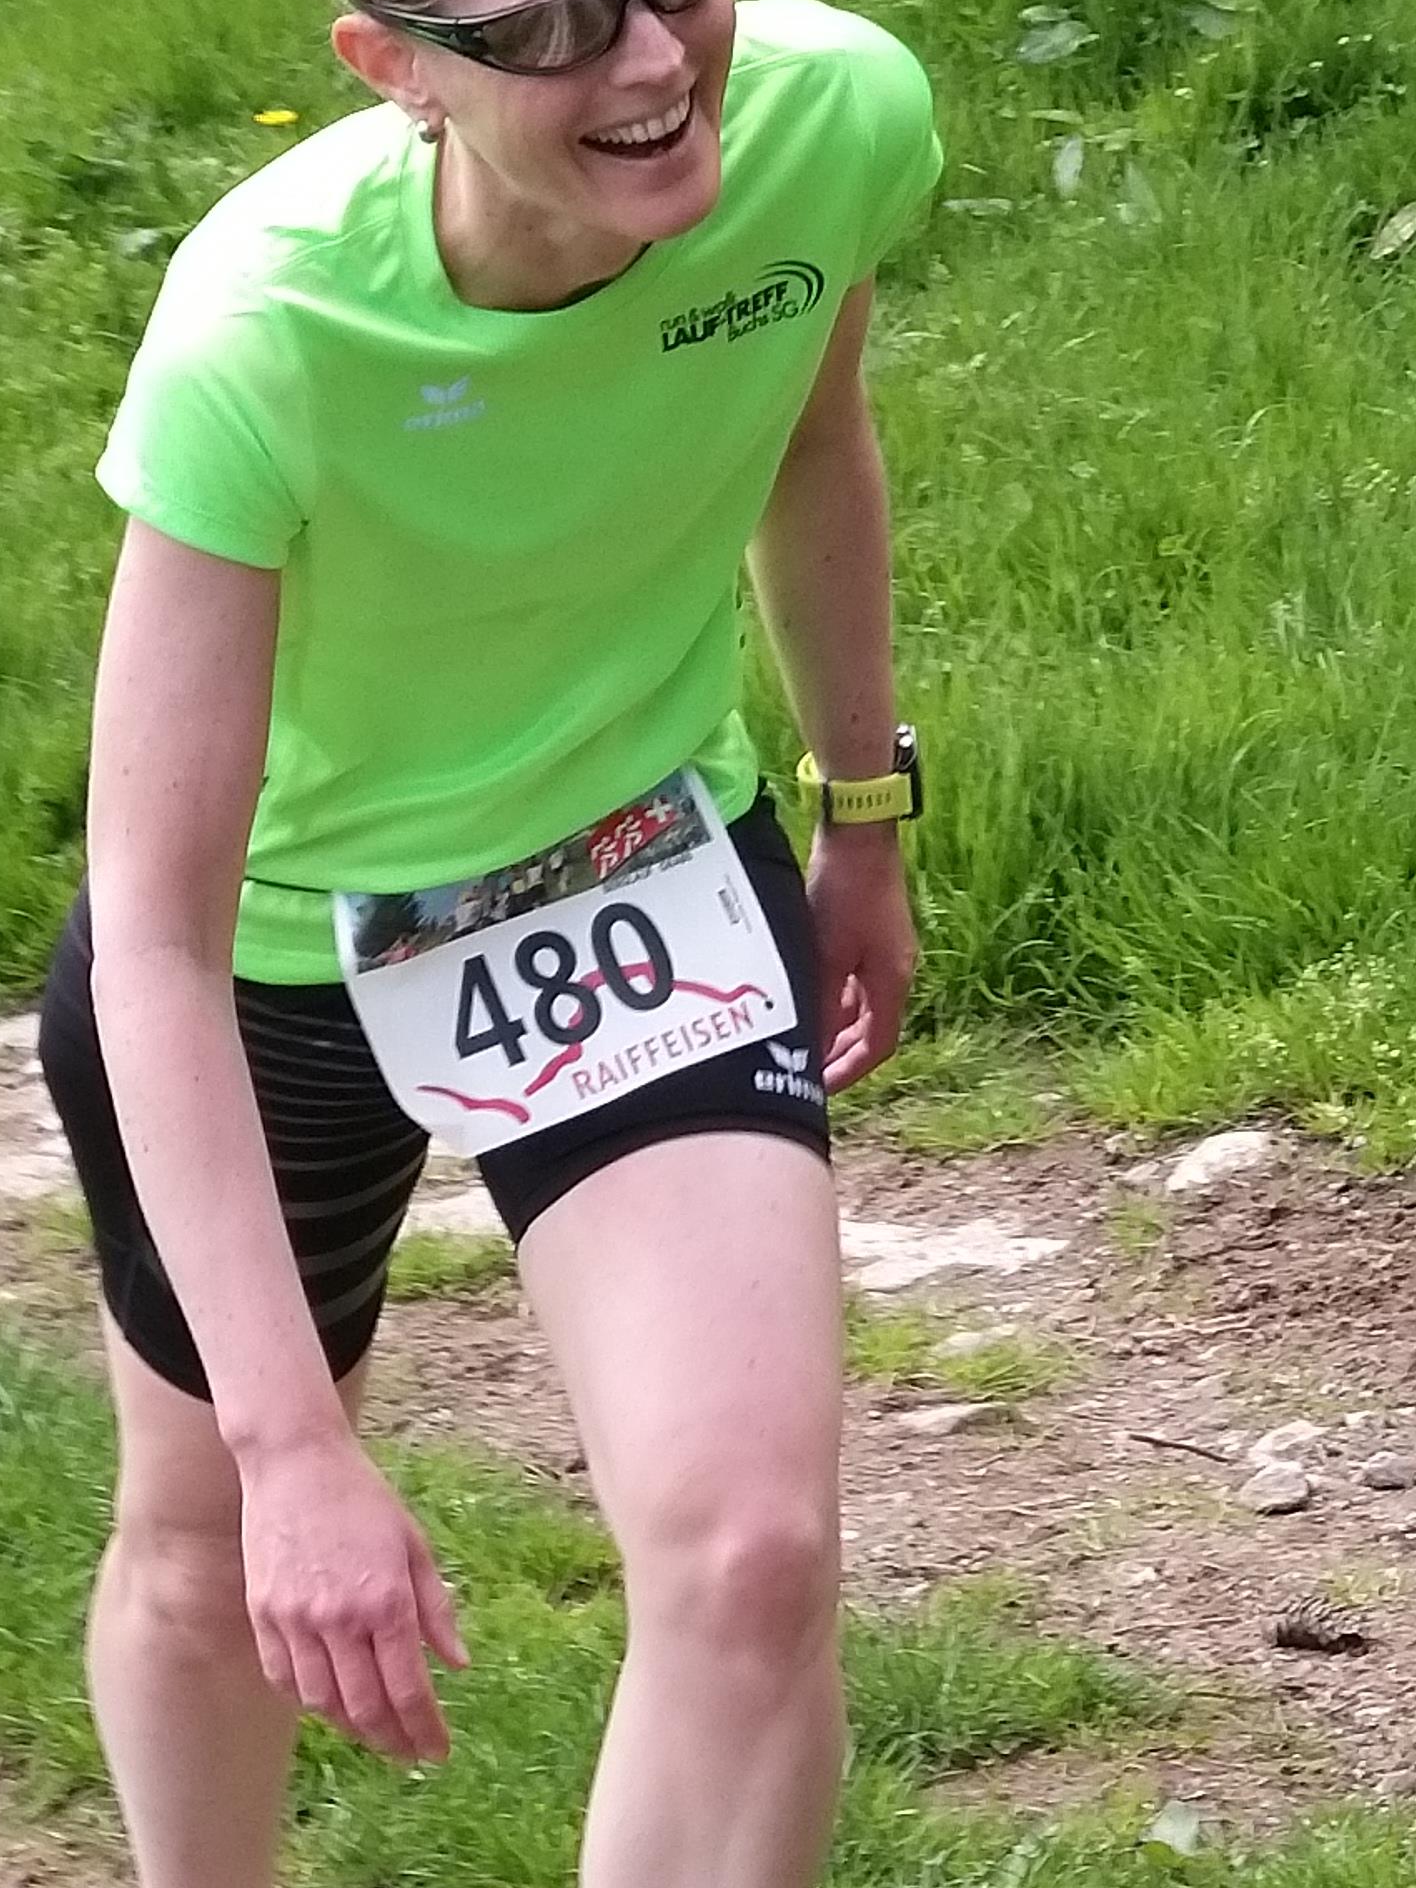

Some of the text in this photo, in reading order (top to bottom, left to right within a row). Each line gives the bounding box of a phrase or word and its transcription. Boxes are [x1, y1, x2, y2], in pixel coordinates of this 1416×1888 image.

[771, 300, 799, 322] SG
[456, 902, 675, 1068] 480
[571, 1001, 754, 1100] RAIFFEISEN
